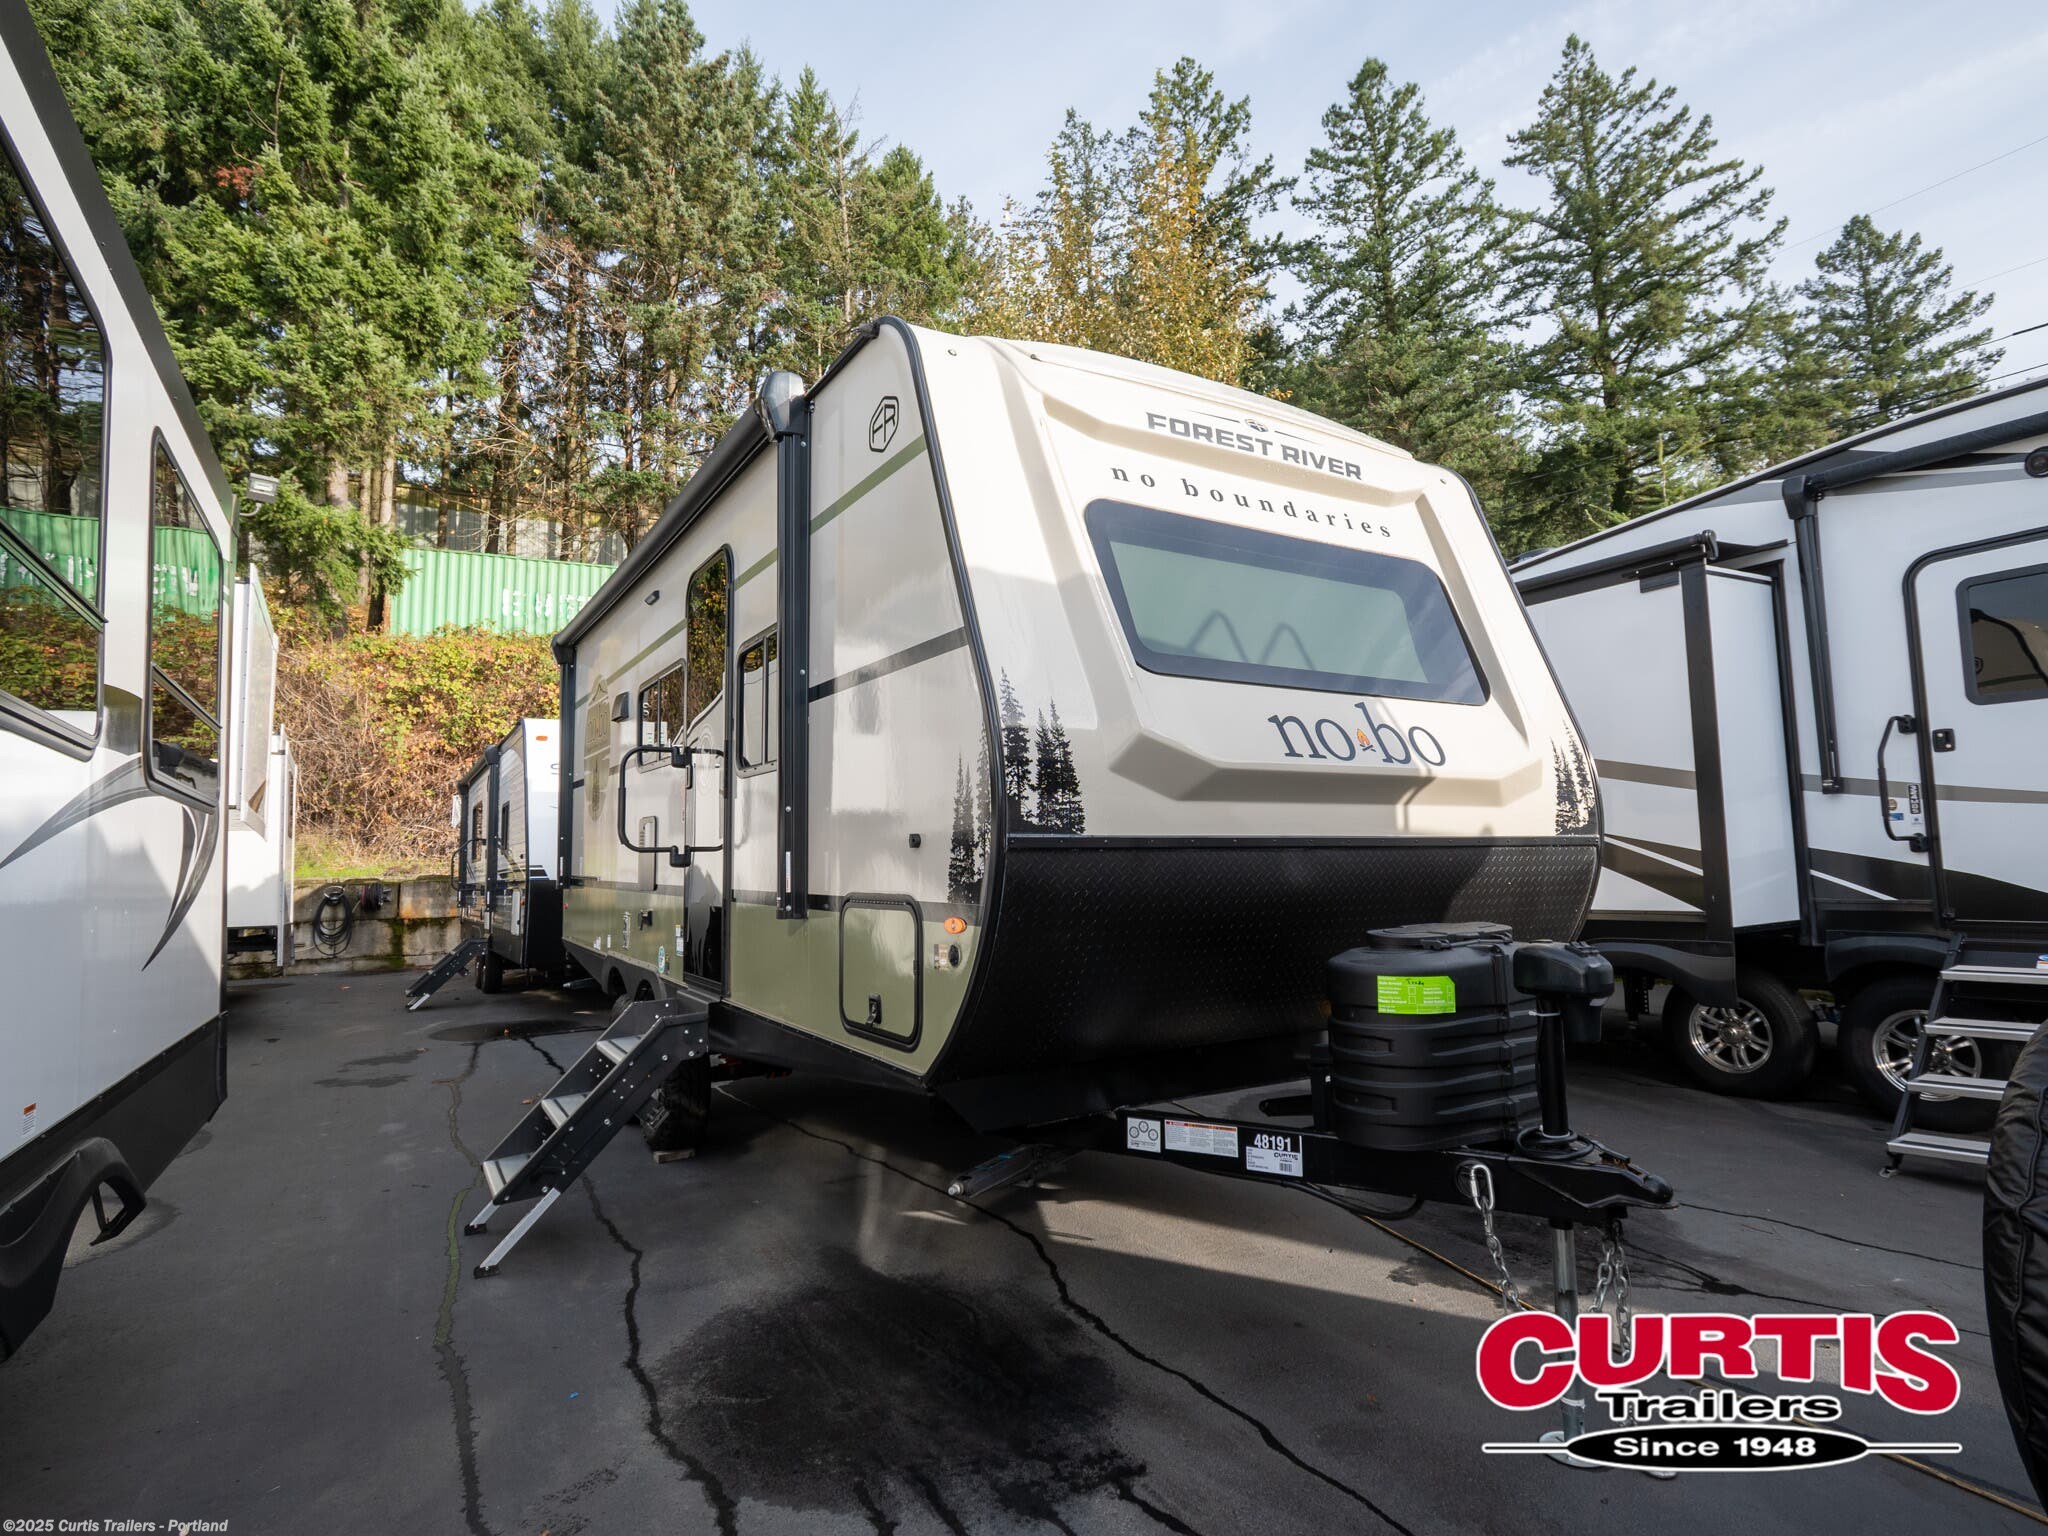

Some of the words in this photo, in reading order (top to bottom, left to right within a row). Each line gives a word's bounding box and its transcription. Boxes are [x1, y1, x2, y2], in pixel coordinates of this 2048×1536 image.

[1146, 412, 1273, 457] FOREST
[1280, 444, 1363, 481] RIVER
[1110, 467, 1156, 488] no
[1180, 477, 1391, 538] boundaries
[1253, 1133, 1292, 1152] 48191
